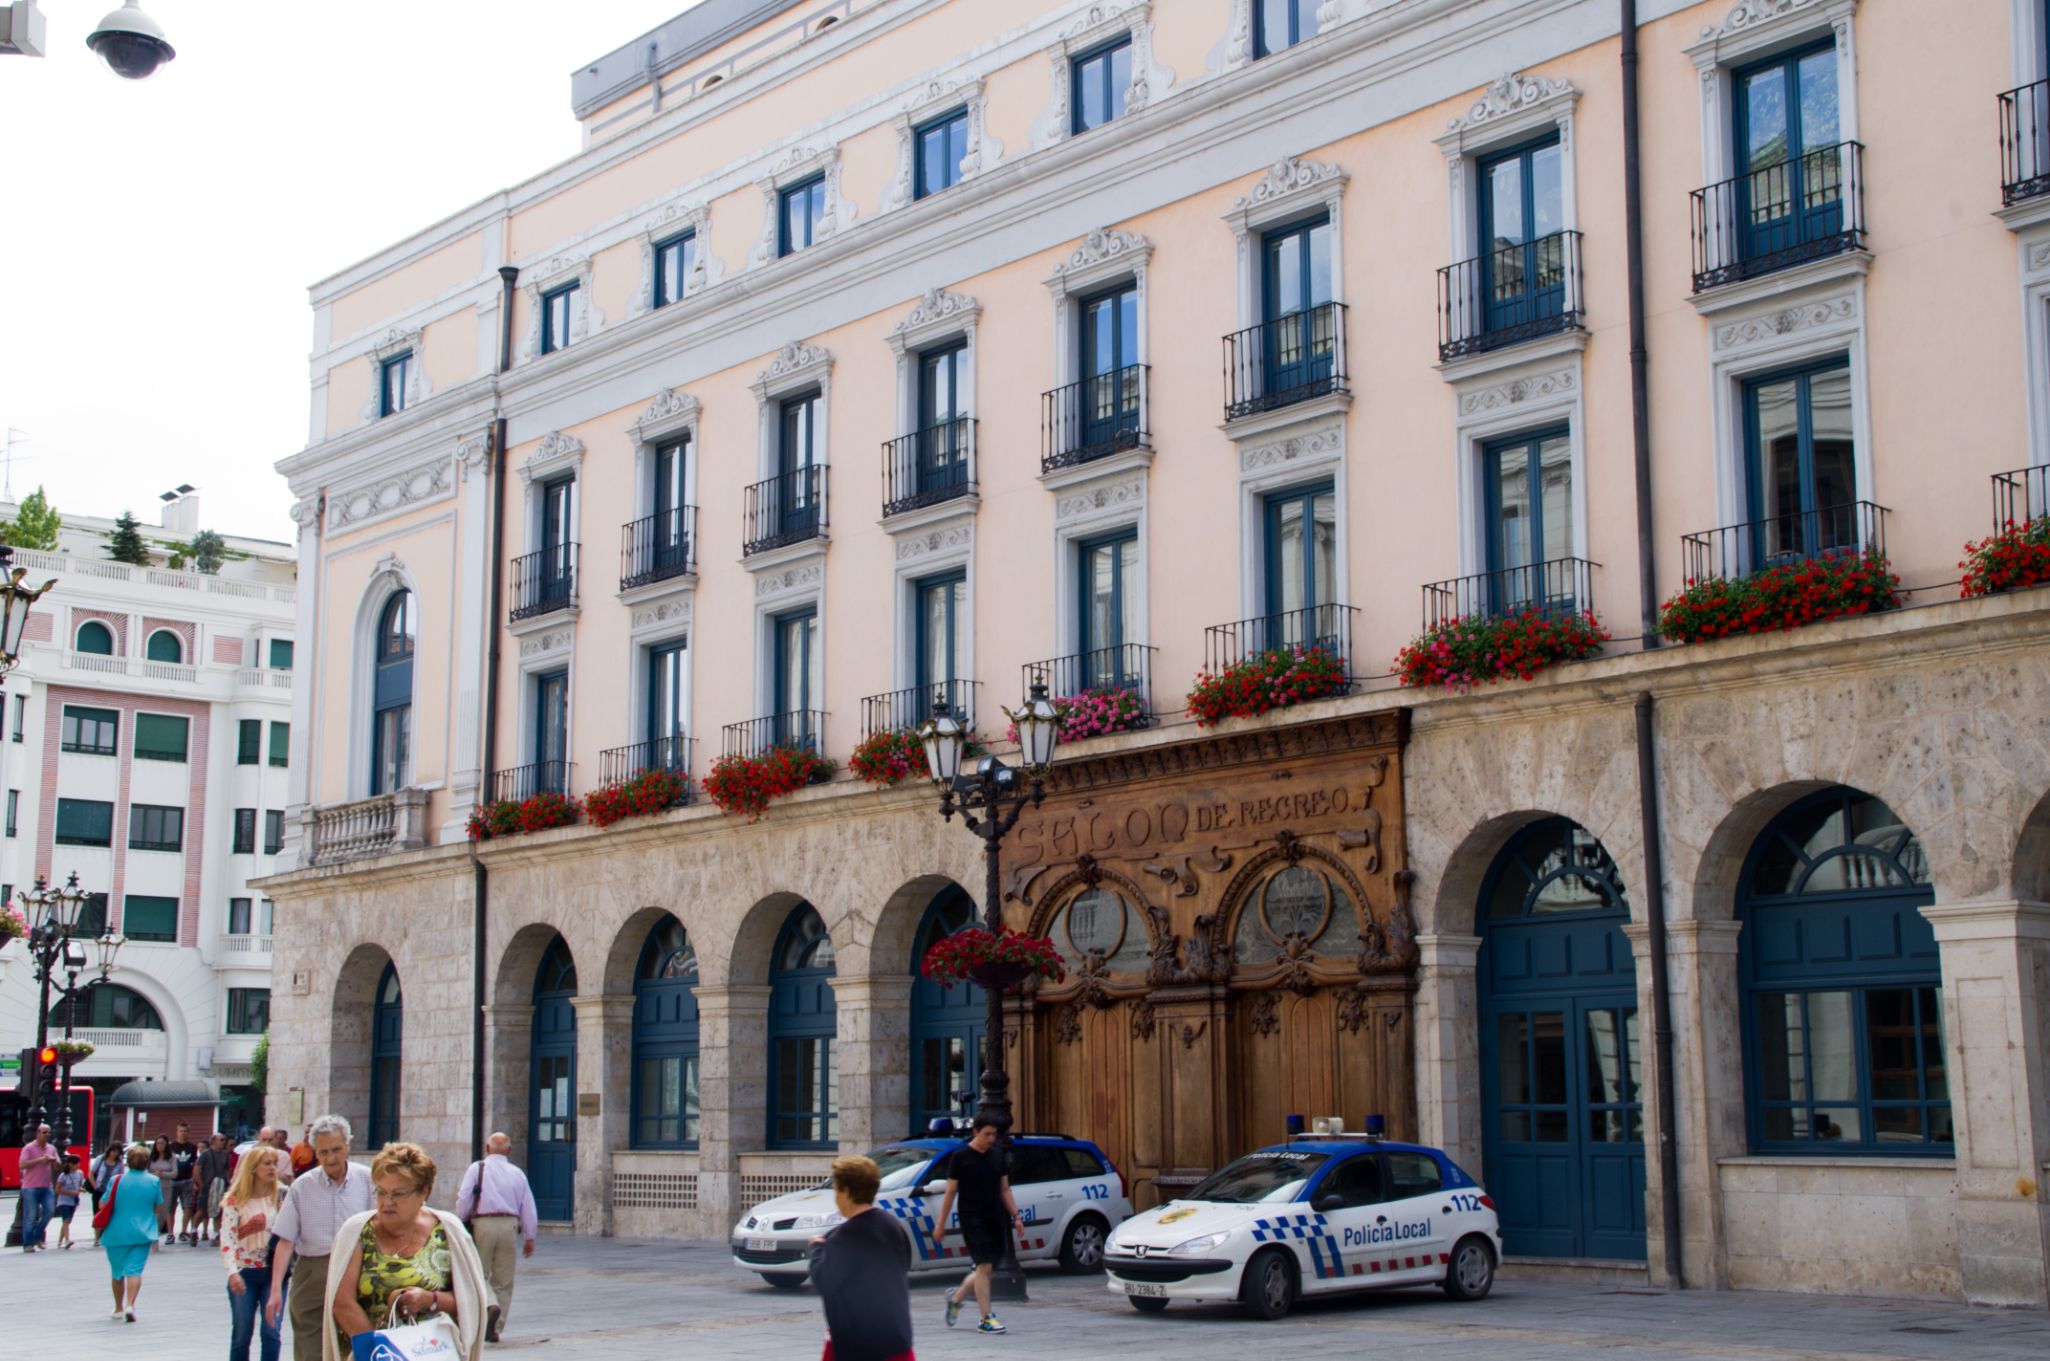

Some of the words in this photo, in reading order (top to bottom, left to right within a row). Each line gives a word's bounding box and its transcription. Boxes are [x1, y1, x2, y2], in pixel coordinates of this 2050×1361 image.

[1017, 803, 1190, 862] SALON
[1197, 803, 1236, 832] DE
[1239, 787, 1349, 828] RECREO
[1081, 1183, 1109, 1200] 112
[1451, 1194, 1482, 1212] 112
[1395, 1217, 1431, 1240] Local
